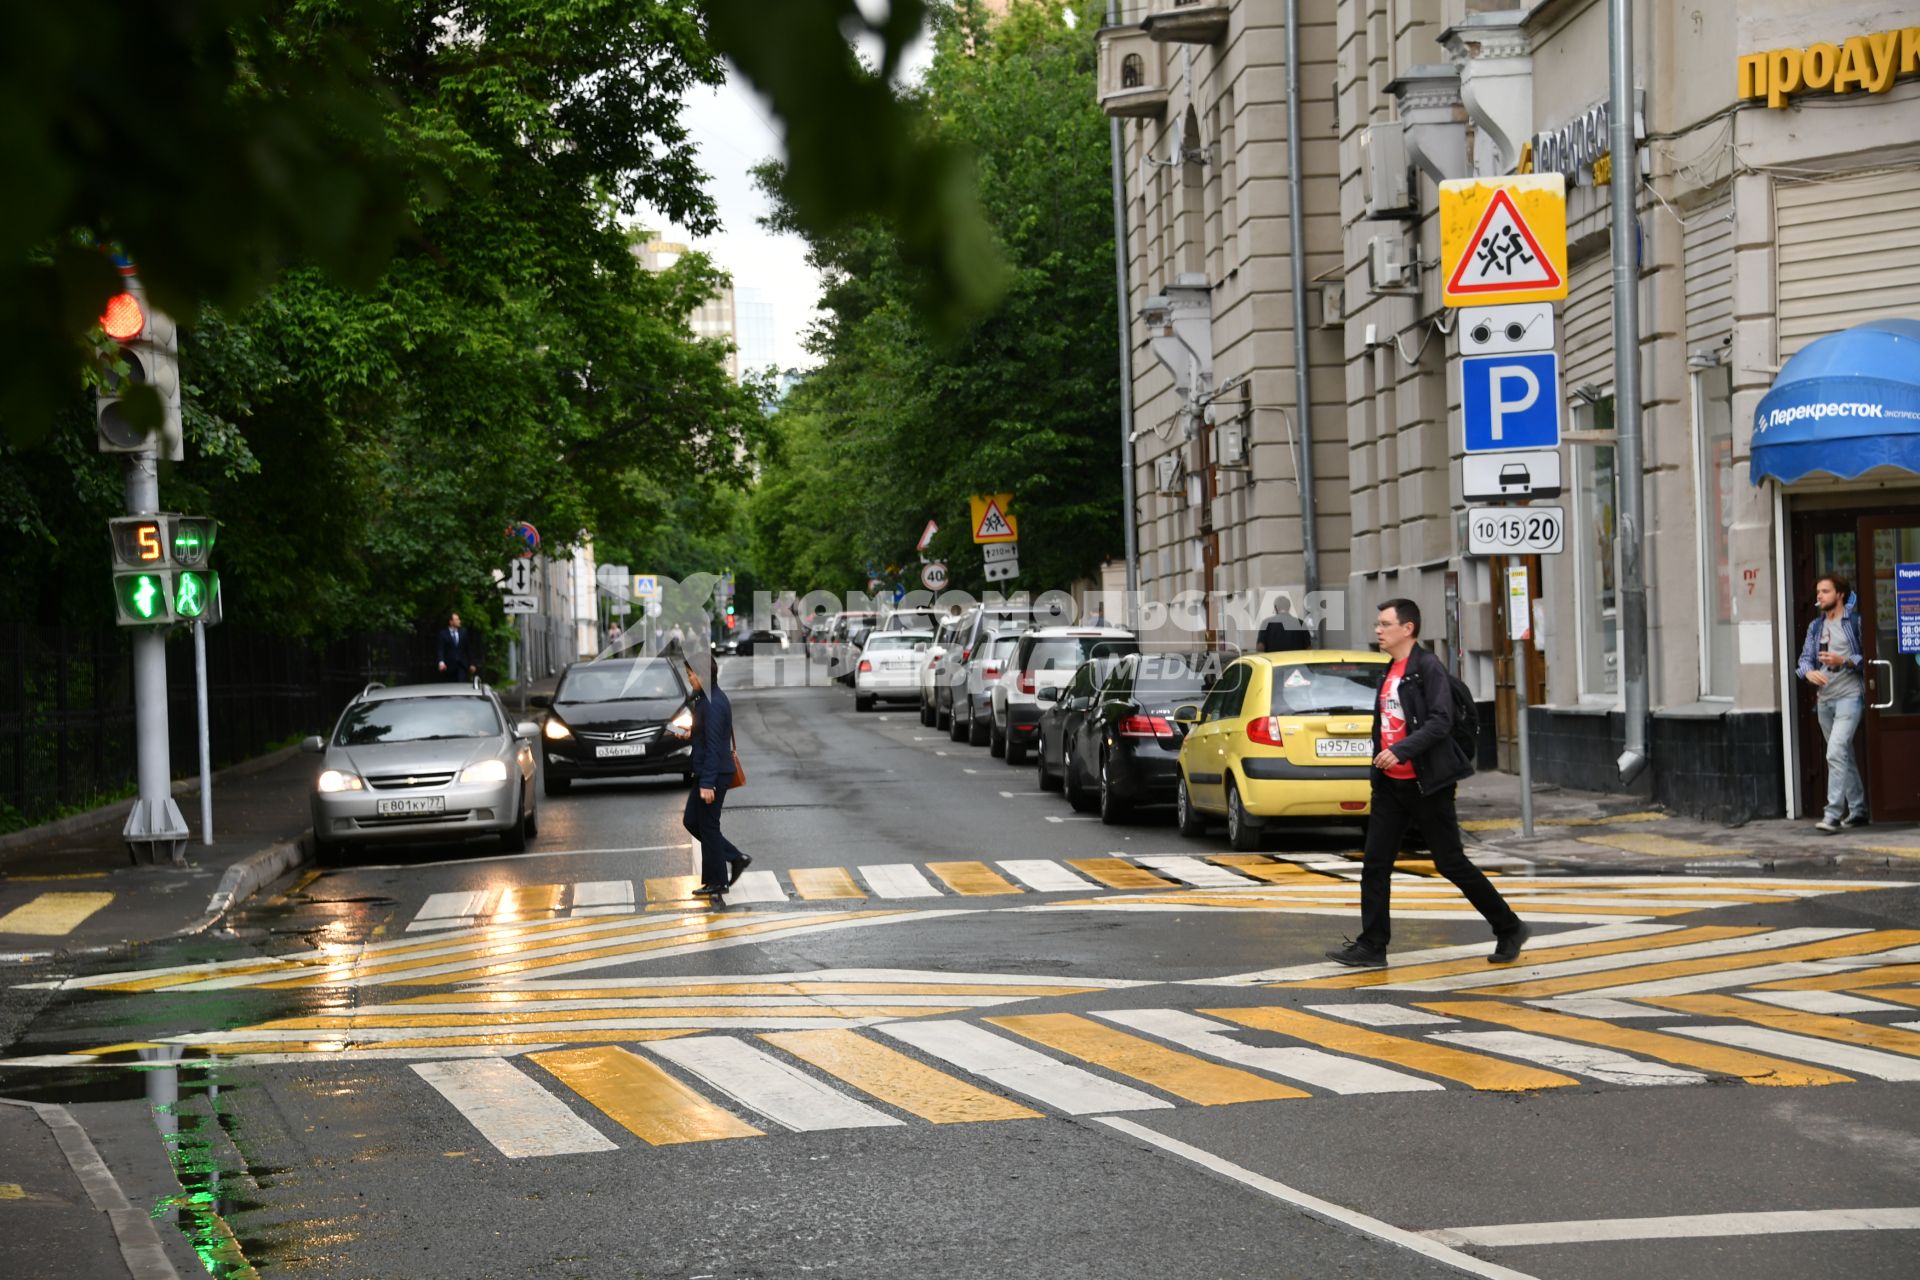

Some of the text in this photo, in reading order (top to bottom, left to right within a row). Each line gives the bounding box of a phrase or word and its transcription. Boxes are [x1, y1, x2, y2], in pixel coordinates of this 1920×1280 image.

[1489, 365, 1540, 440] P
[1769, 403, 1882, 427] Перекресток
[1478, 518, 1554, 541] 10 15 20
[139, 527, 159, 559] 5
[927, 570, 944, 582] 40
[1747, 583, 1755, 595] 7
